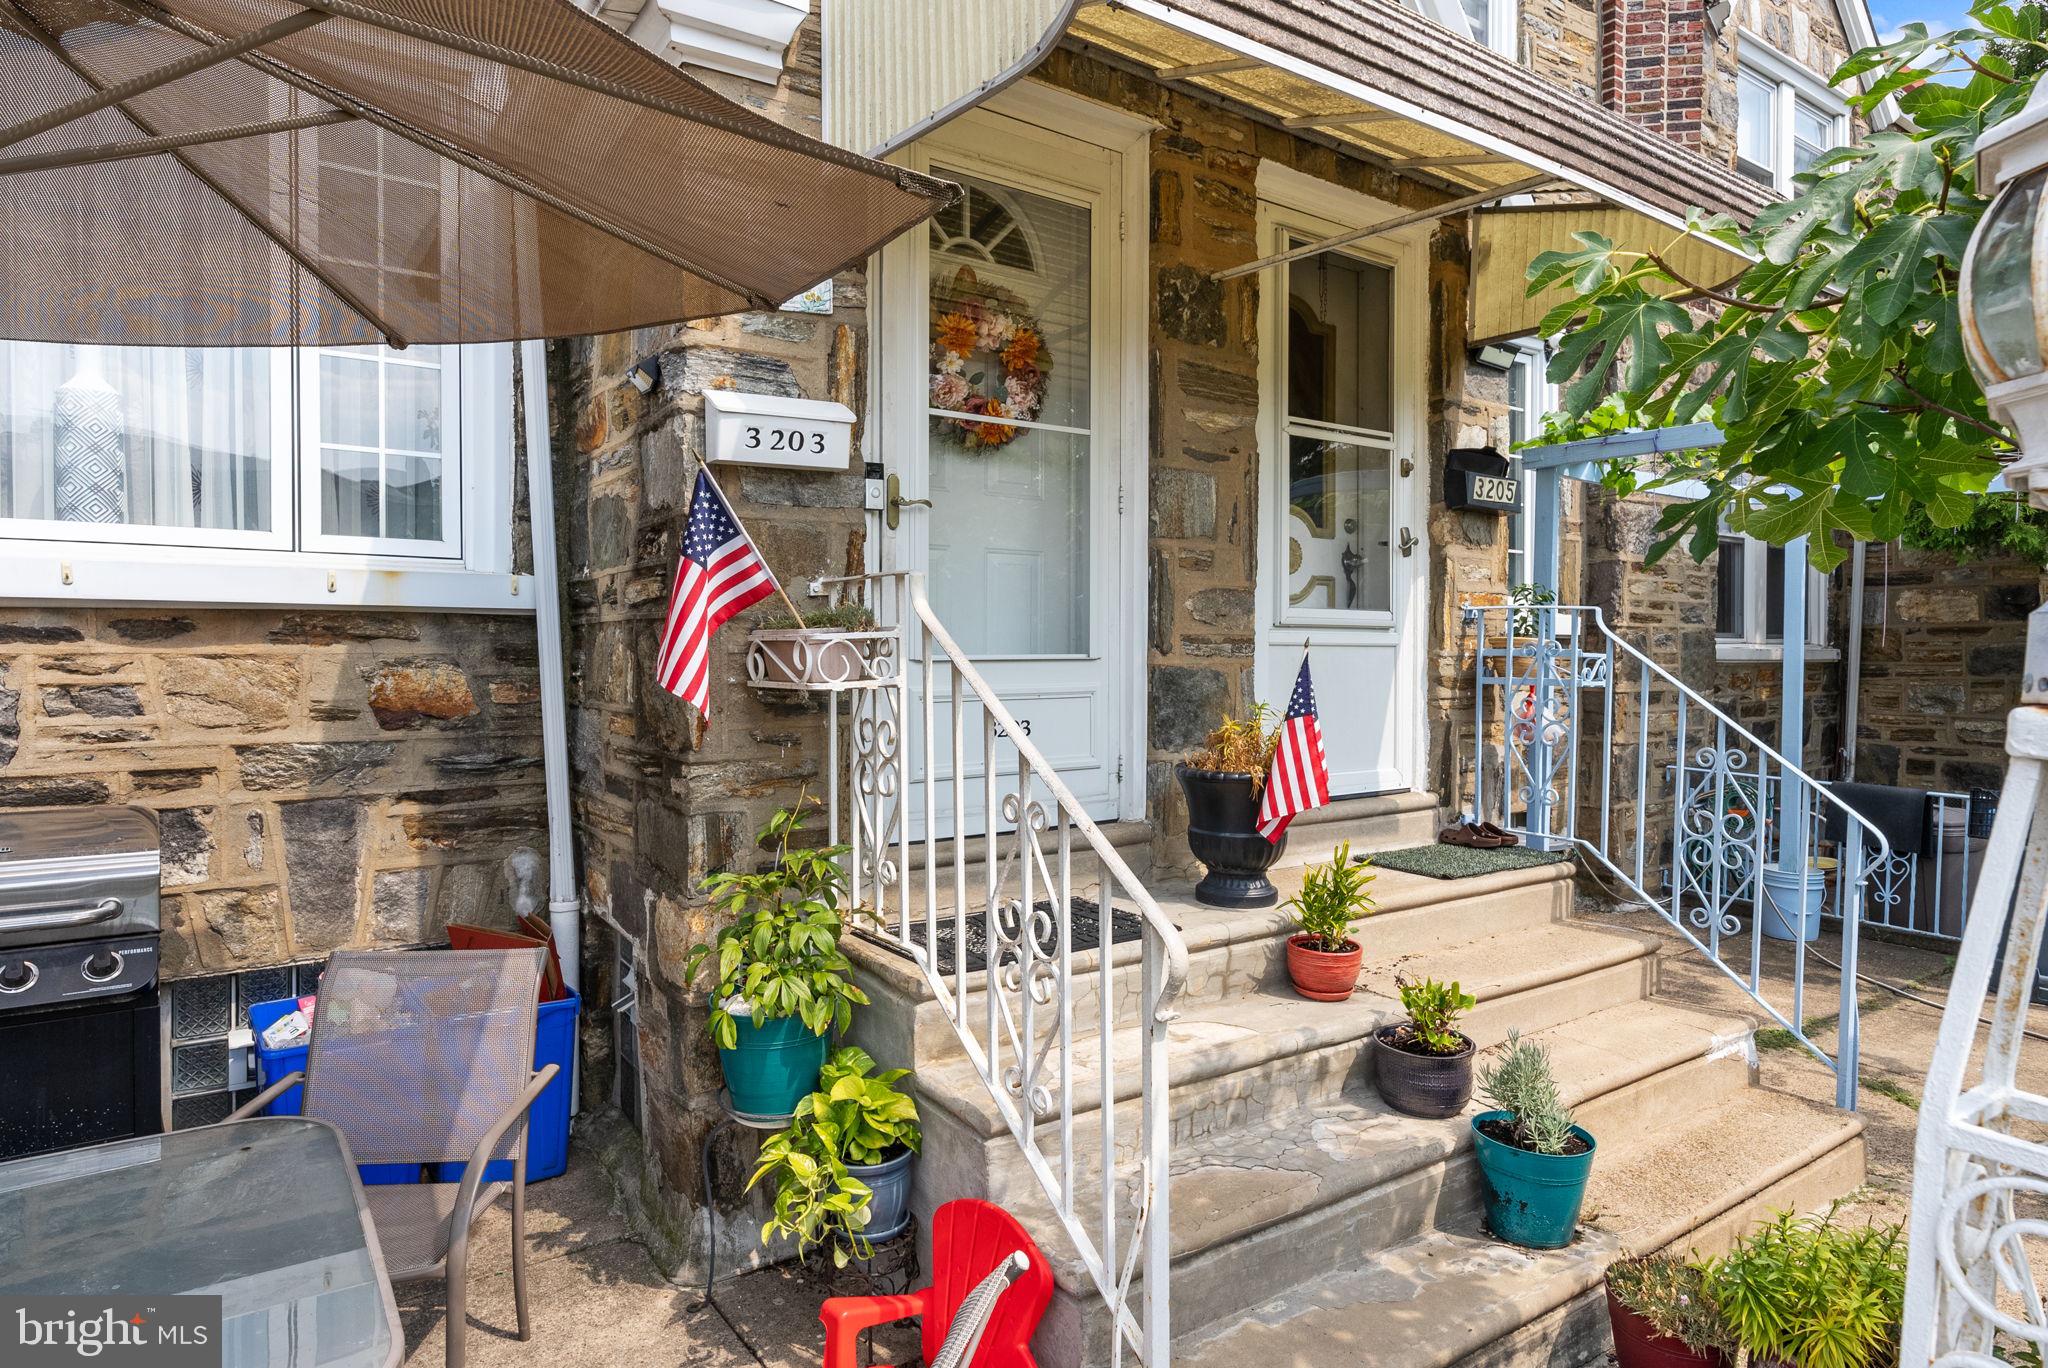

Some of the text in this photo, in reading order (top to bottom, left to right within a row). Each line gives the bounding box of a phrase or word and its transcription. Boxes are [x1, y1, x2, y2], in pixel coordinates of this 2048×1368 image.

[744, 427, 826, 454] 3203
[1475, 478, 1515, 502] 3205
[118, 946, 153, 956] PERFORMANCE
